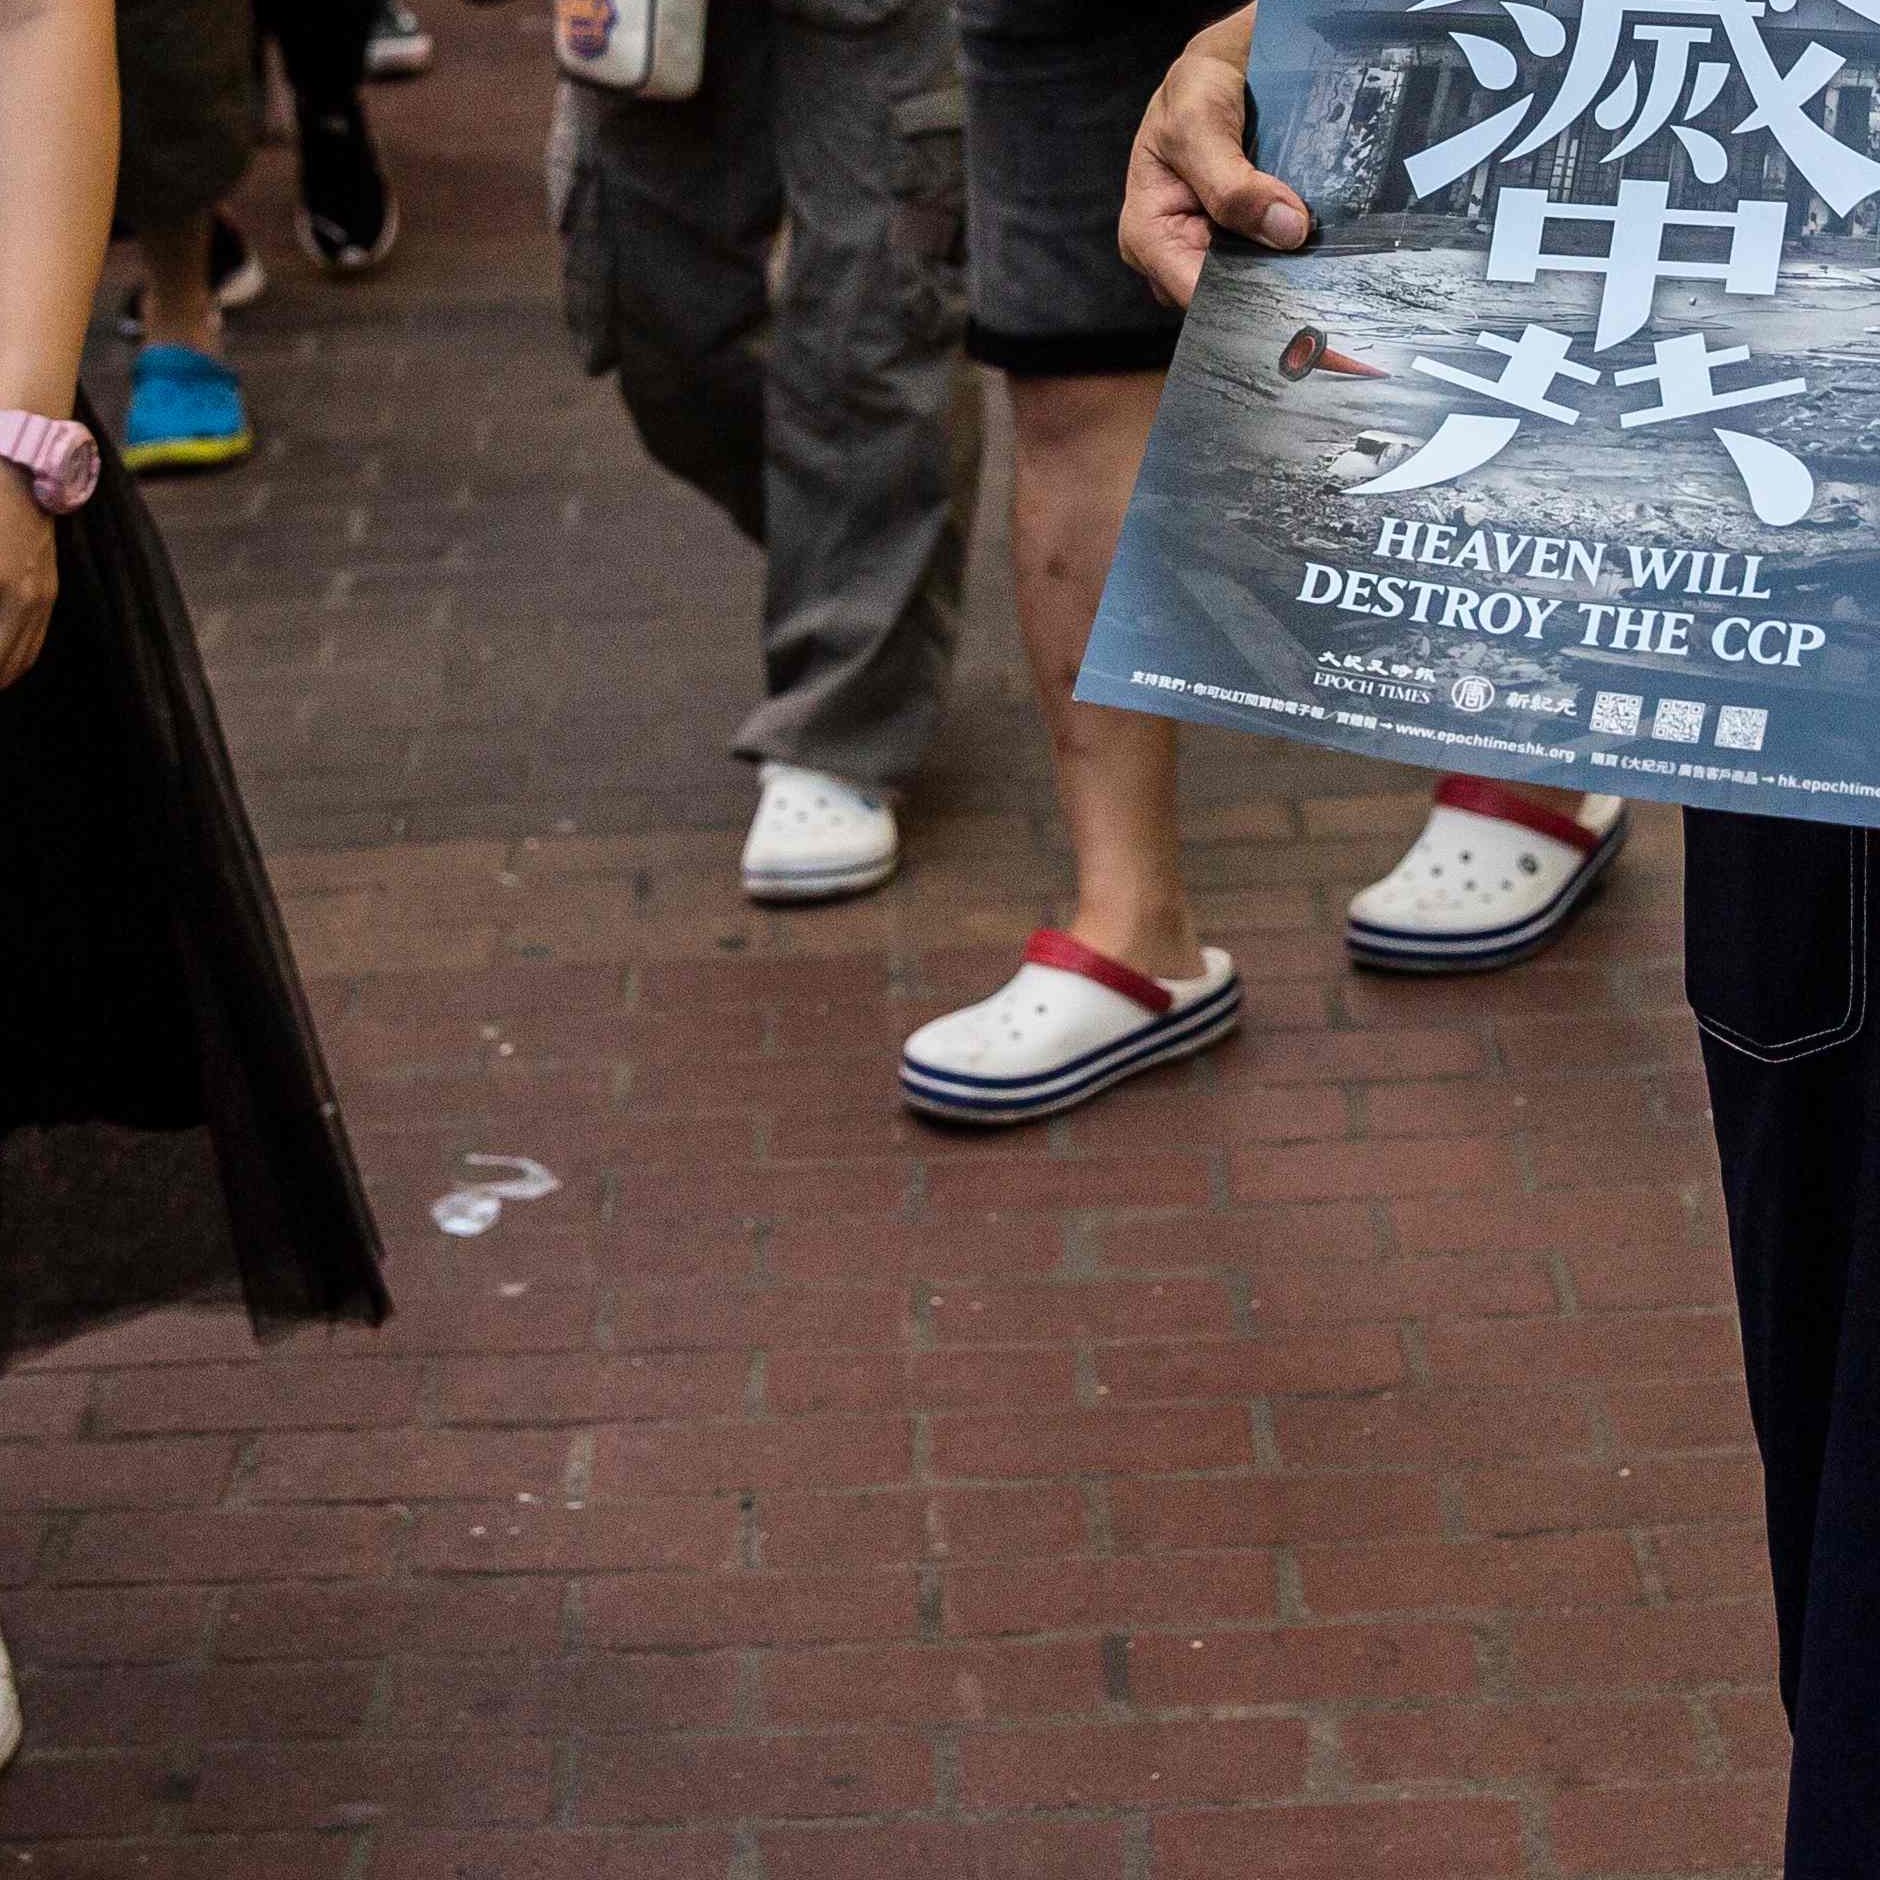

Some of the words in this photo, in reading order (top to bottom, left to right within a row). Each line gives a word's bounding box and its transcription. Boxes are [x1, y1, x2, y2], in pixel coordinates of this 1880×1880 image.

[1372, 516, 1607, 586] HEAVEN
[1624, 545, 1772, 600] WILL
[1296, 562, 1563, 641] DESTROY
[1577, 602, 1695, 657] THE
[1710, 617, 1826, 667] CCP
[1313, 671, 1374, 696] EPOCH
[1378, 681, 1430, 705] TIMES
[1506, 691, 1577, 716] 新紀元
[1395, 722, 1576, 763] www.epochtimeshk.org
